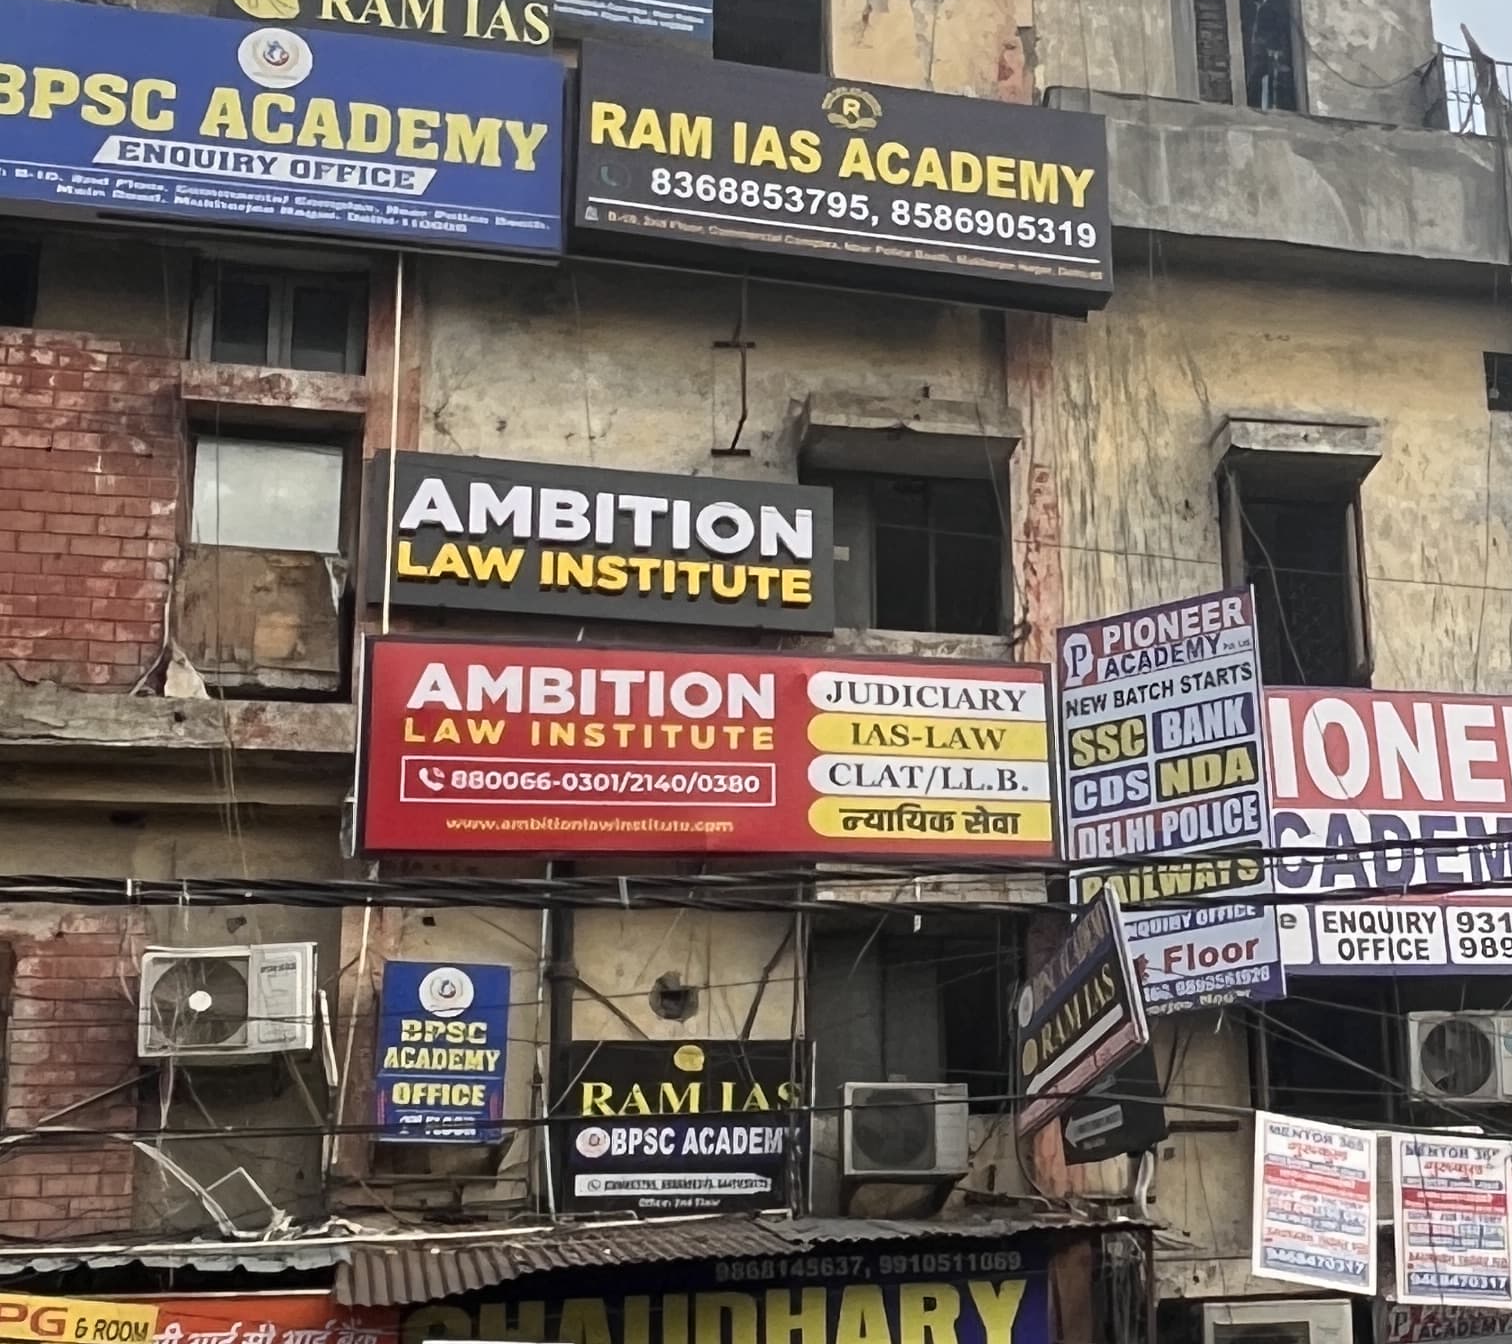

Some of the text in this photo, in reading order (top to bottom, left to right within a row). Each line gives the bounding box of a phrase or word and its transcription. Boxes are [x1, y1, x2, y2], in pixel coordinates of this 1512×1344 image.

[0, 64, 548, 171] BPSC ACADEMY
[118, 141, 416, 191] ENQUIRY OFFICE
[591, 101, 1095, 208] RAM IAS ACADEMY
[651, 167, 880, 227] 8368853795,
[891, 199, 1097, 250] 8586905319
[399, 478, 813, 559] AMBITION
[397, 540, 813, 605] LAW INSTITUTE
[1103, 596, 1243, 654] PIONEER
[1103, 633, 1220, 680] ACADEMY
[406, 661, 775, 719] AMBITION
[826, 679, 1027, 713] JUDICIARY
[1065, 663, 1252, 718] NEW BATCH STARTS
[404, 717, 774, 751] LAW INSTITUTE
[851, 721, 1006, 752] IAS-LAW
[1071, 696, 1248, 767] SSC BANK
[451, 768, 760, 794] 880066-0301/2140/0380
[829, 763, 1029, 794] CLAT/LL.B.
[1073, 747, 1254, 812] CDS NDA
[965, 805, 1020, 836] सेवा
[1079, 795, 1259, 860] DELHI POLICE
[1127, 913, 1192, 940] NQUIRY
[1196, 904, 1257, 926] OFFICE
[1323, 911, 1437, 936] ENQUIRY
[1164, 938, 1260, 975] Floor
[1337, 937, 1430, 962] OFFICE
[401, 1019, 488, 1044] BPSC
[384, 1046, 500, 1072] ACADEMY
[392, 1082, 487, 1106] OFFICE
[581, 1080, 702, 1116] RAM
[611, 1127, 676, 1155] BPSC
[0, 1302, 69, 1337] PG
[93, 1318, 149, 1342] ROOM
[1419, 1314, 1510, 1339] ACADEMY
